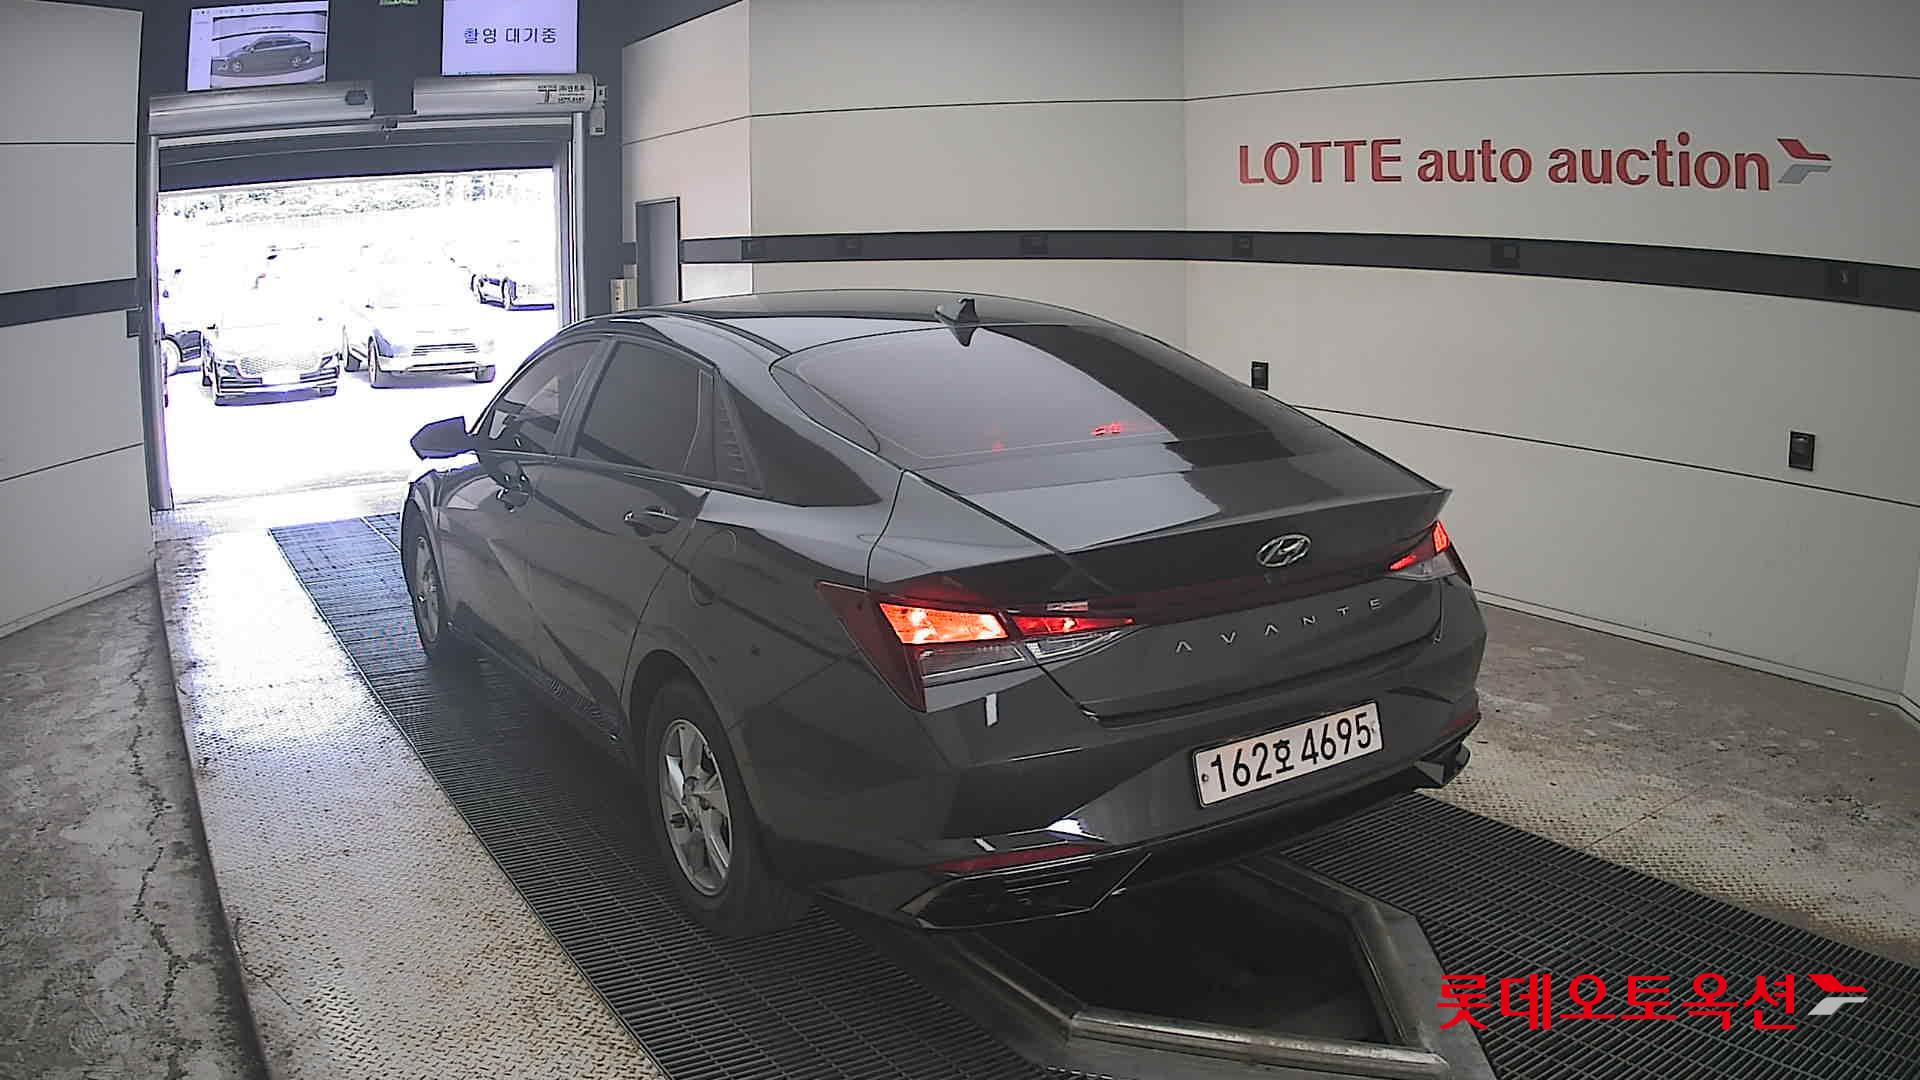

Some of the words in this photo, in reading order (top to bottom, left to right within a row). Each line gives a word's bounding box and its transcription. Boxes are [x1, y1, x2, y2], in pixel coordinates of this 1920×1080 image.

[505, 27, 556, 43] 대기중
[1239, 138, 1402, 185] LOTTE
[1417, 139, 1532, 184] auto
[1547, 131, 1771, 192] auction
[1175, 598, 1382, 653] AVANTE
